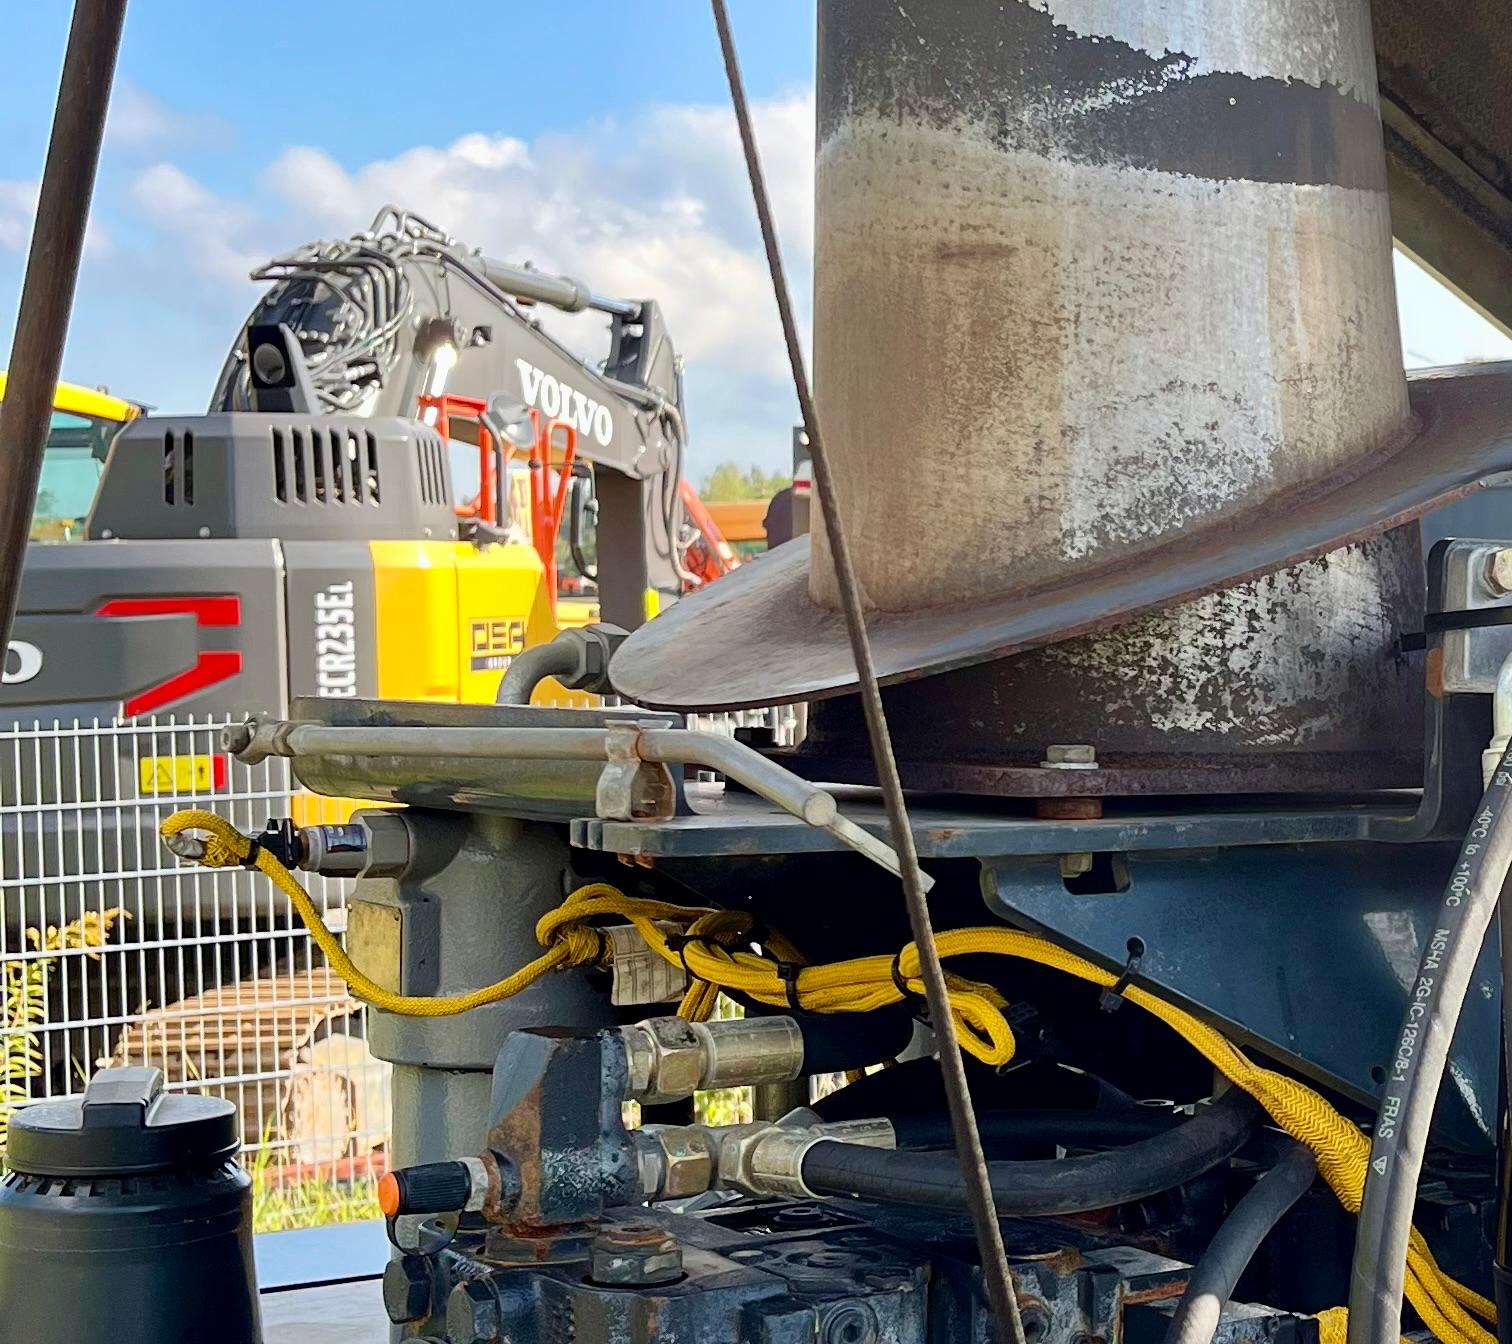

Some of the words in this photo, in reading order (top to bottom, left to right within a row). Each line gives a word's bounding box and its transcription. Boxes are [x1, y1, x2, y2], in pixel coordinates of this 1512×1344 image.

[516, 358, 613, 447] VOLVO
[1465, 844, 1480, 855] to
[1424, 928, 1450, 970] MSHA
[1379, 1096, 1401, 1139] FRAS
